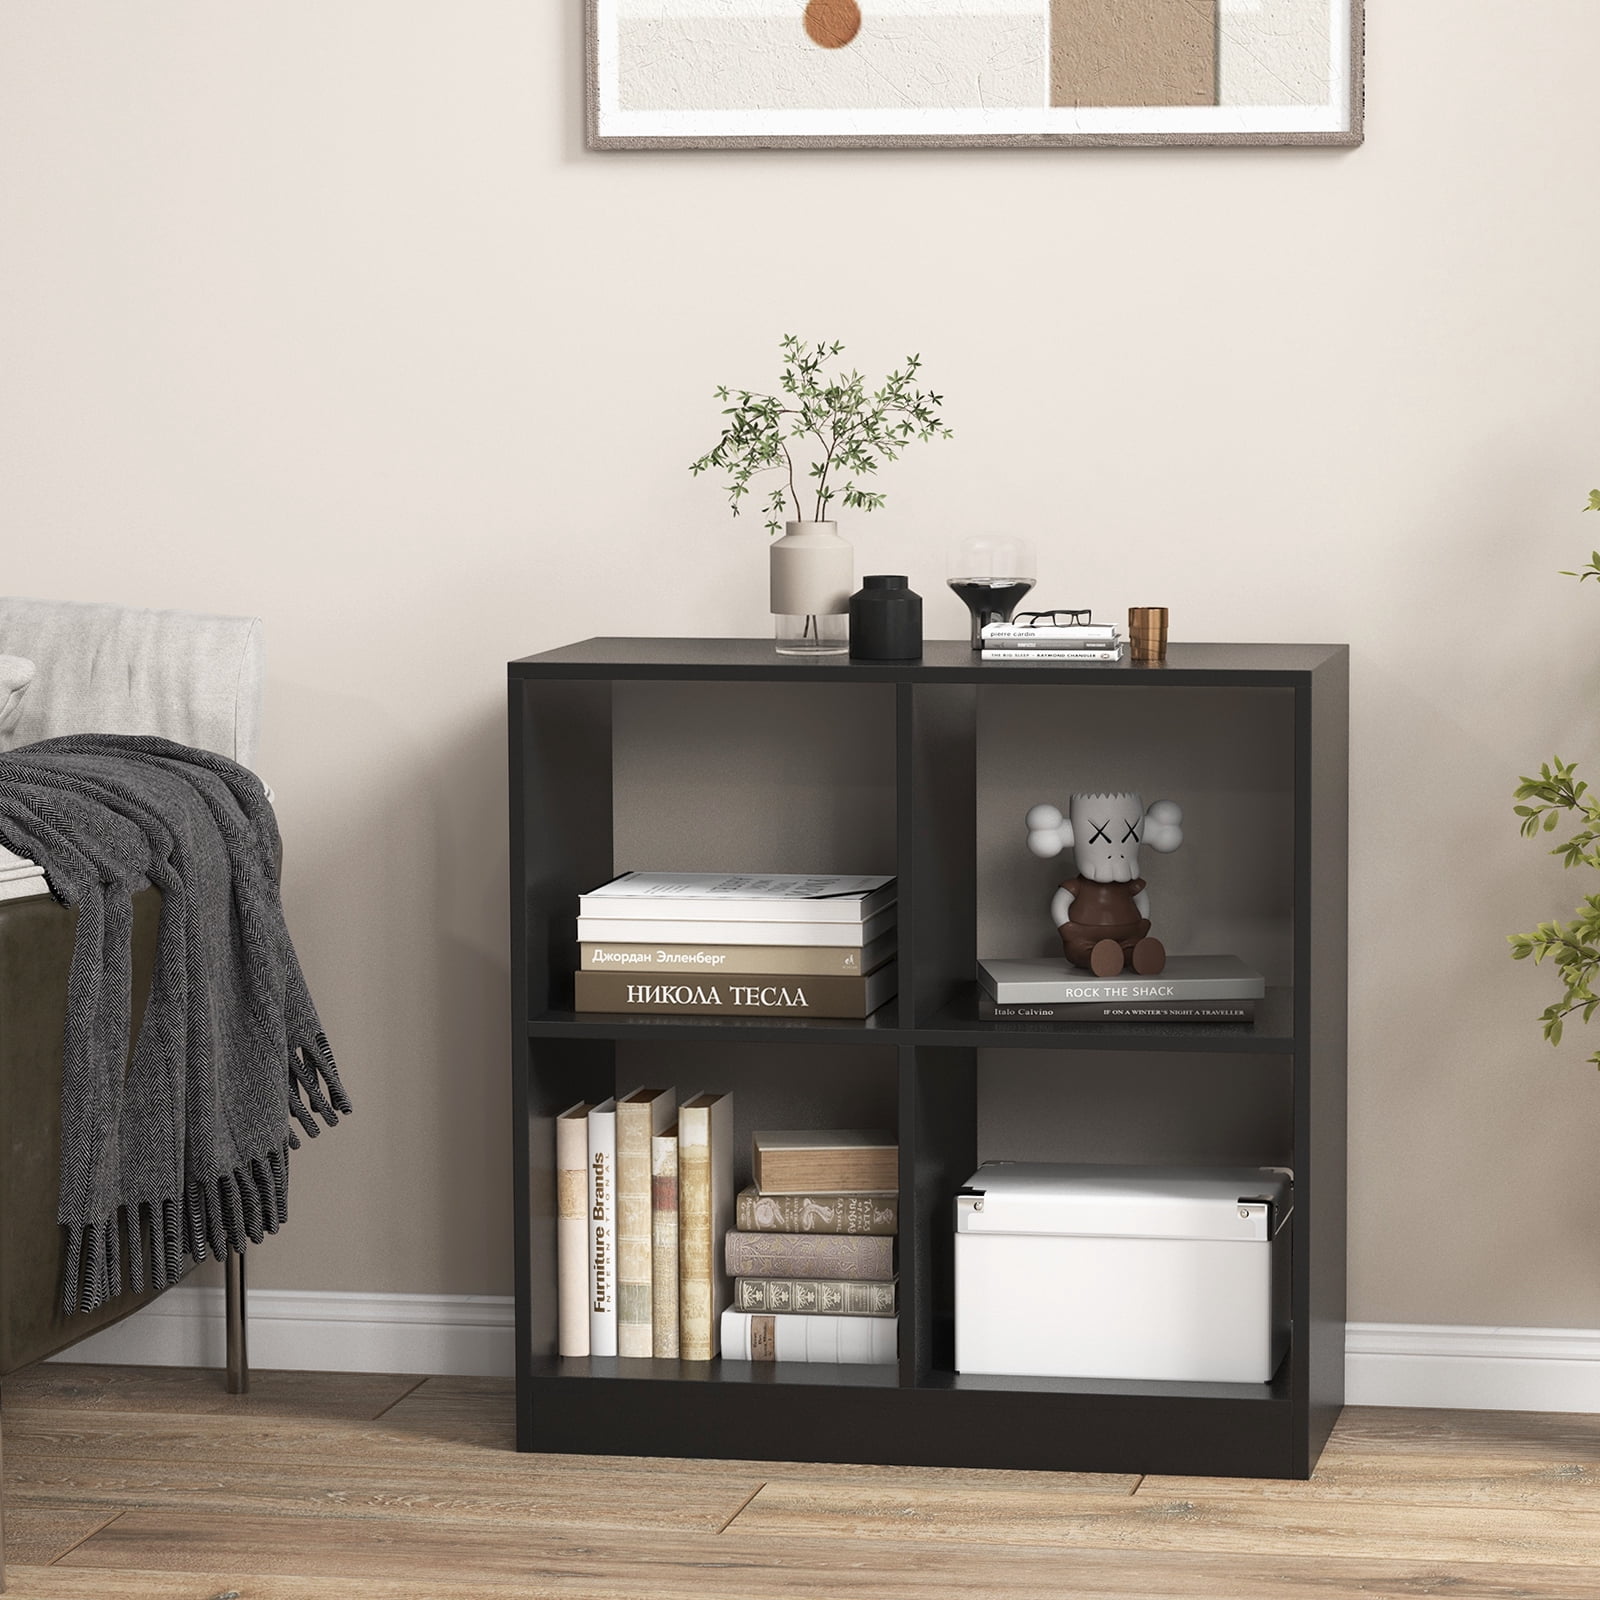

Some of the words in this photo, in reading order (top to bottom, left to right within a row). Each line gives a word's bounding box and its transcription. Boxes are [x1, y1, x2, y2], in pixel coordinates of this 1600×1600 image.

[592, 950, 651, 965] Джордан
[656, 950, 726, 966] Элленберг
[626, 985, 722, 1005] НИКОЛА
[729, 986, 808, 1007] ТЕСЛА
[1065, 988, 1100, 998] ROCK
[1104, 987, 1128, 997] THE
[1132, 986, 1174, 997] SHACK
[994, 1008, 1015, 1016] Italo
[1017, 1008, 1054, 1016] Calvino
[592, 1152, 605, 1220] Brands
[593, 1226, 606, 1312] Furniture
